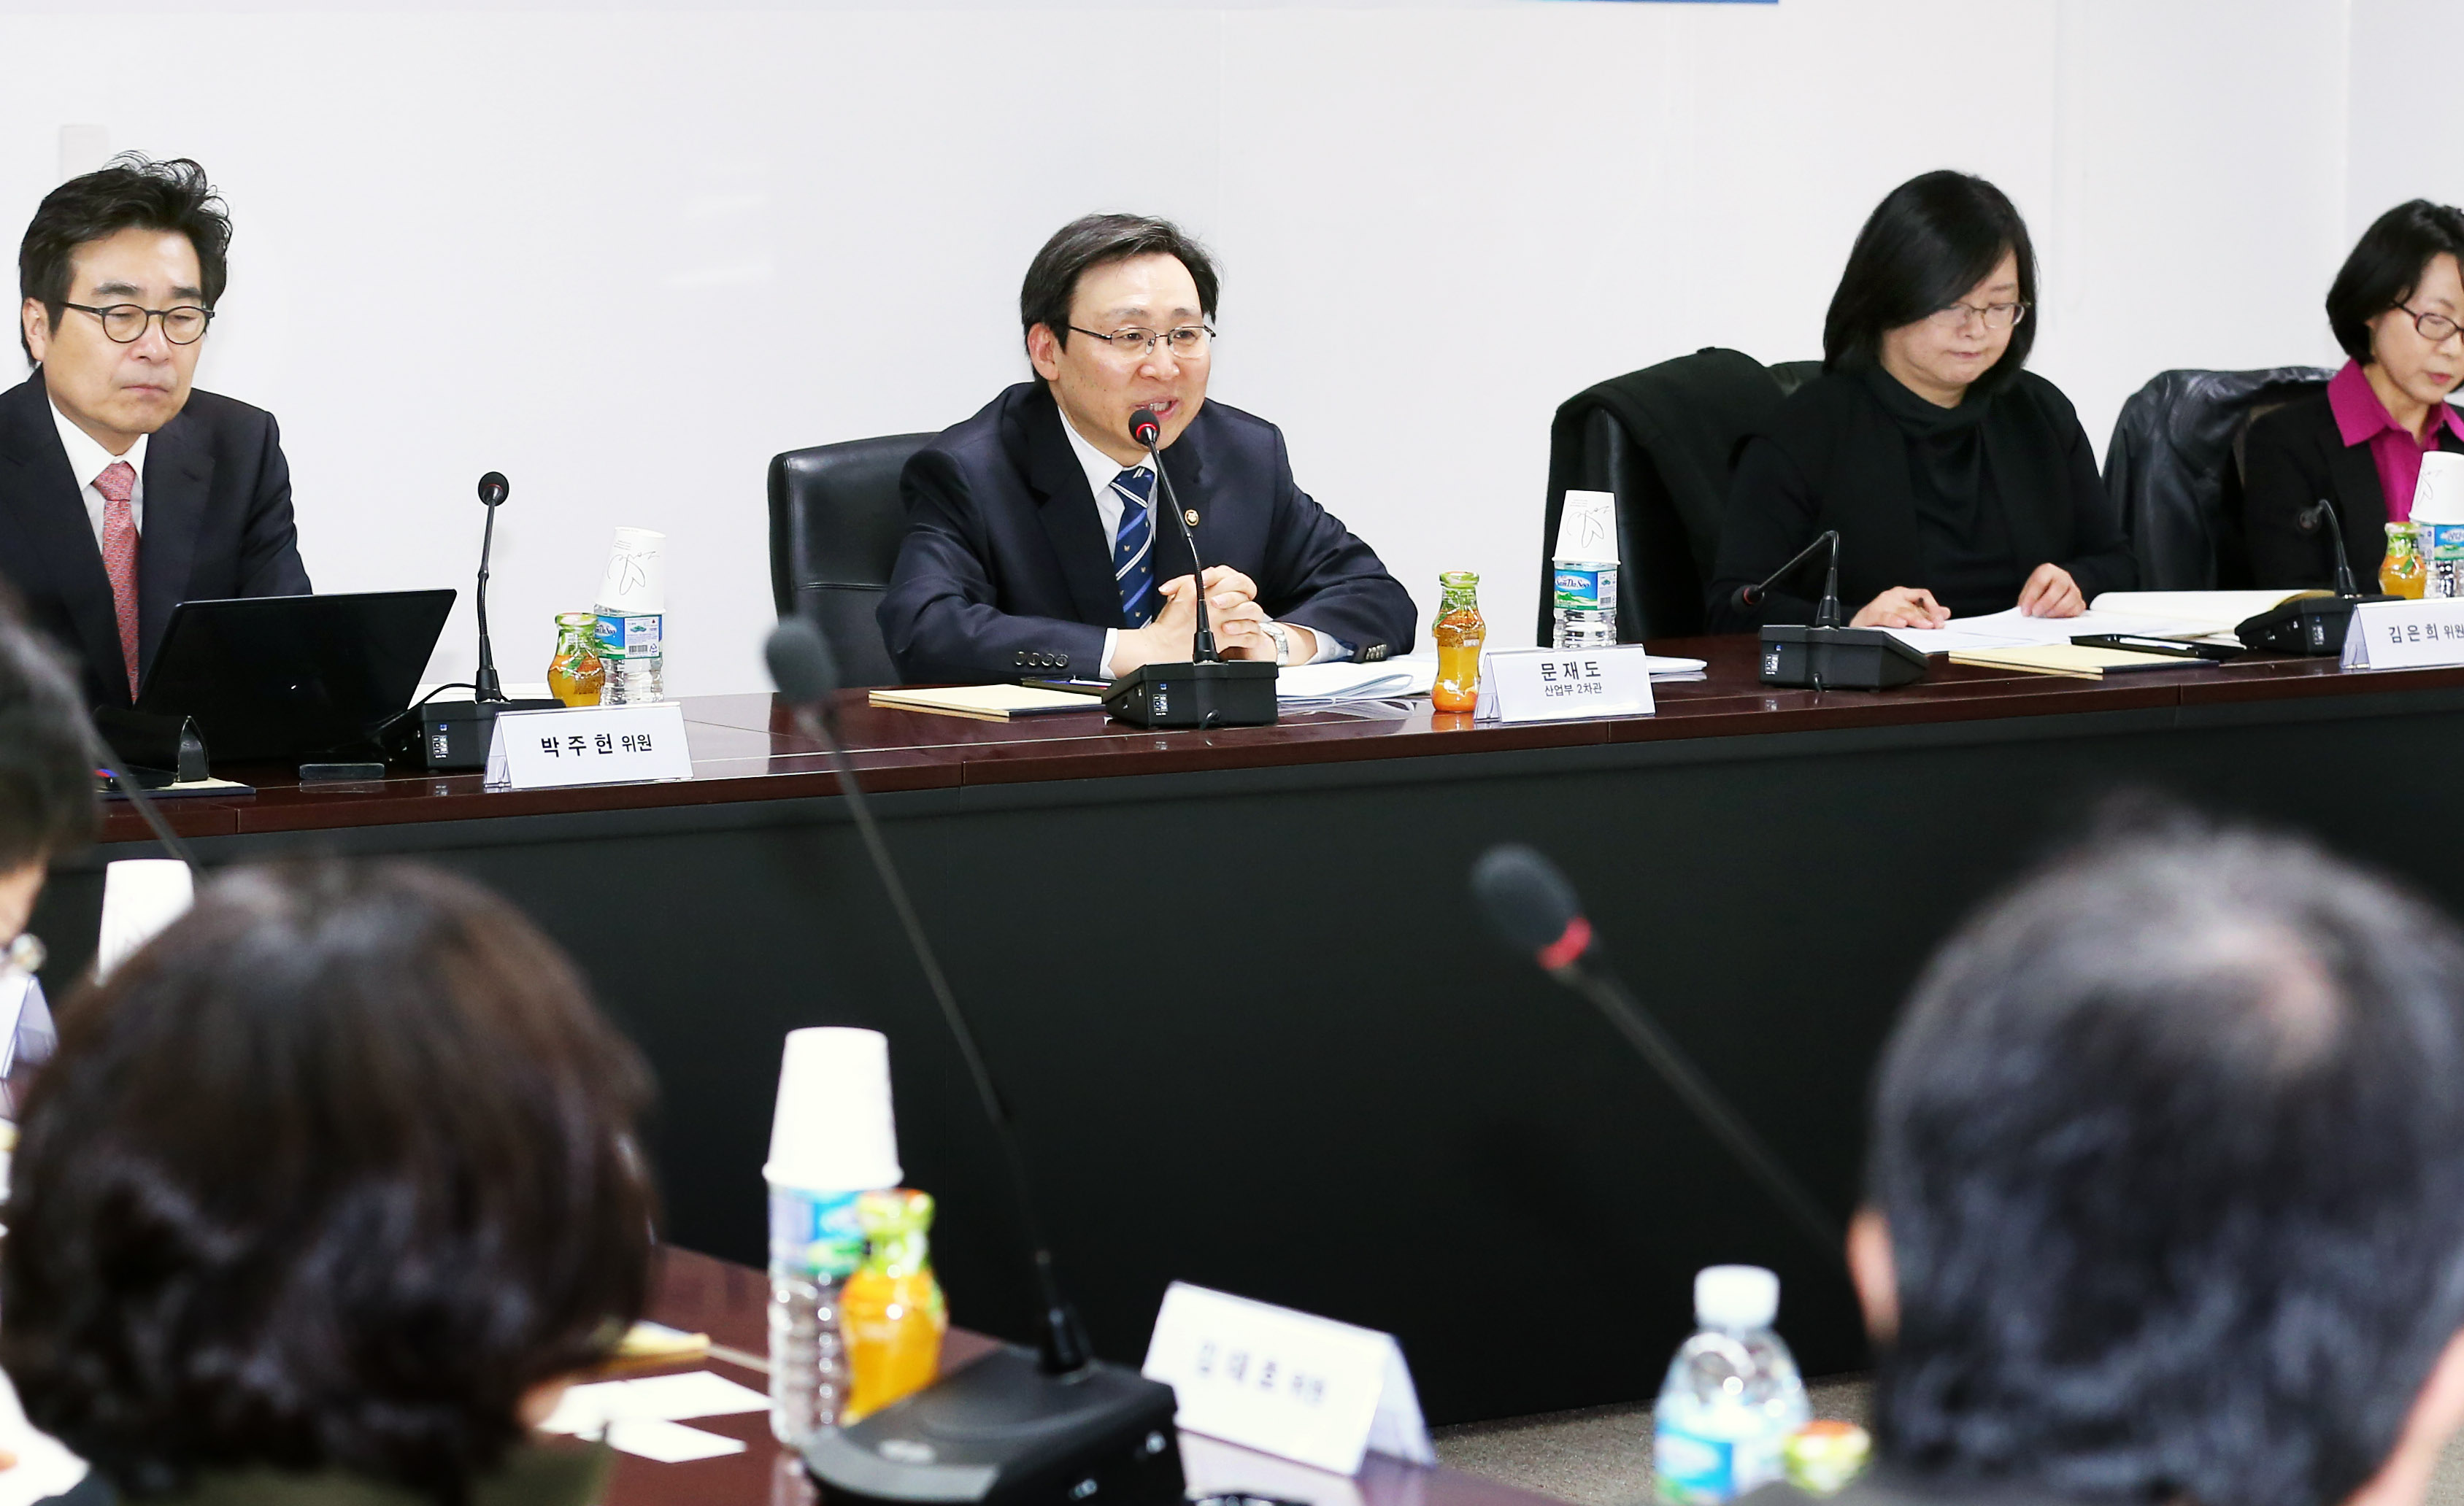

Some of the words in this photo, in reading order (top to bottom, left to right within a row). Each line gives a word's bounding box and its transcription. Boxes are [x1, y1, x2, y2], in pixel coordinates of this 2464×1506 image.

[2444, 623, 2464, 640] 위원
[1544, 684, 1574, 697] 산업부
[1576, 682, 1602, 695] 2차관
[621, 733, 652, 753] 위원
